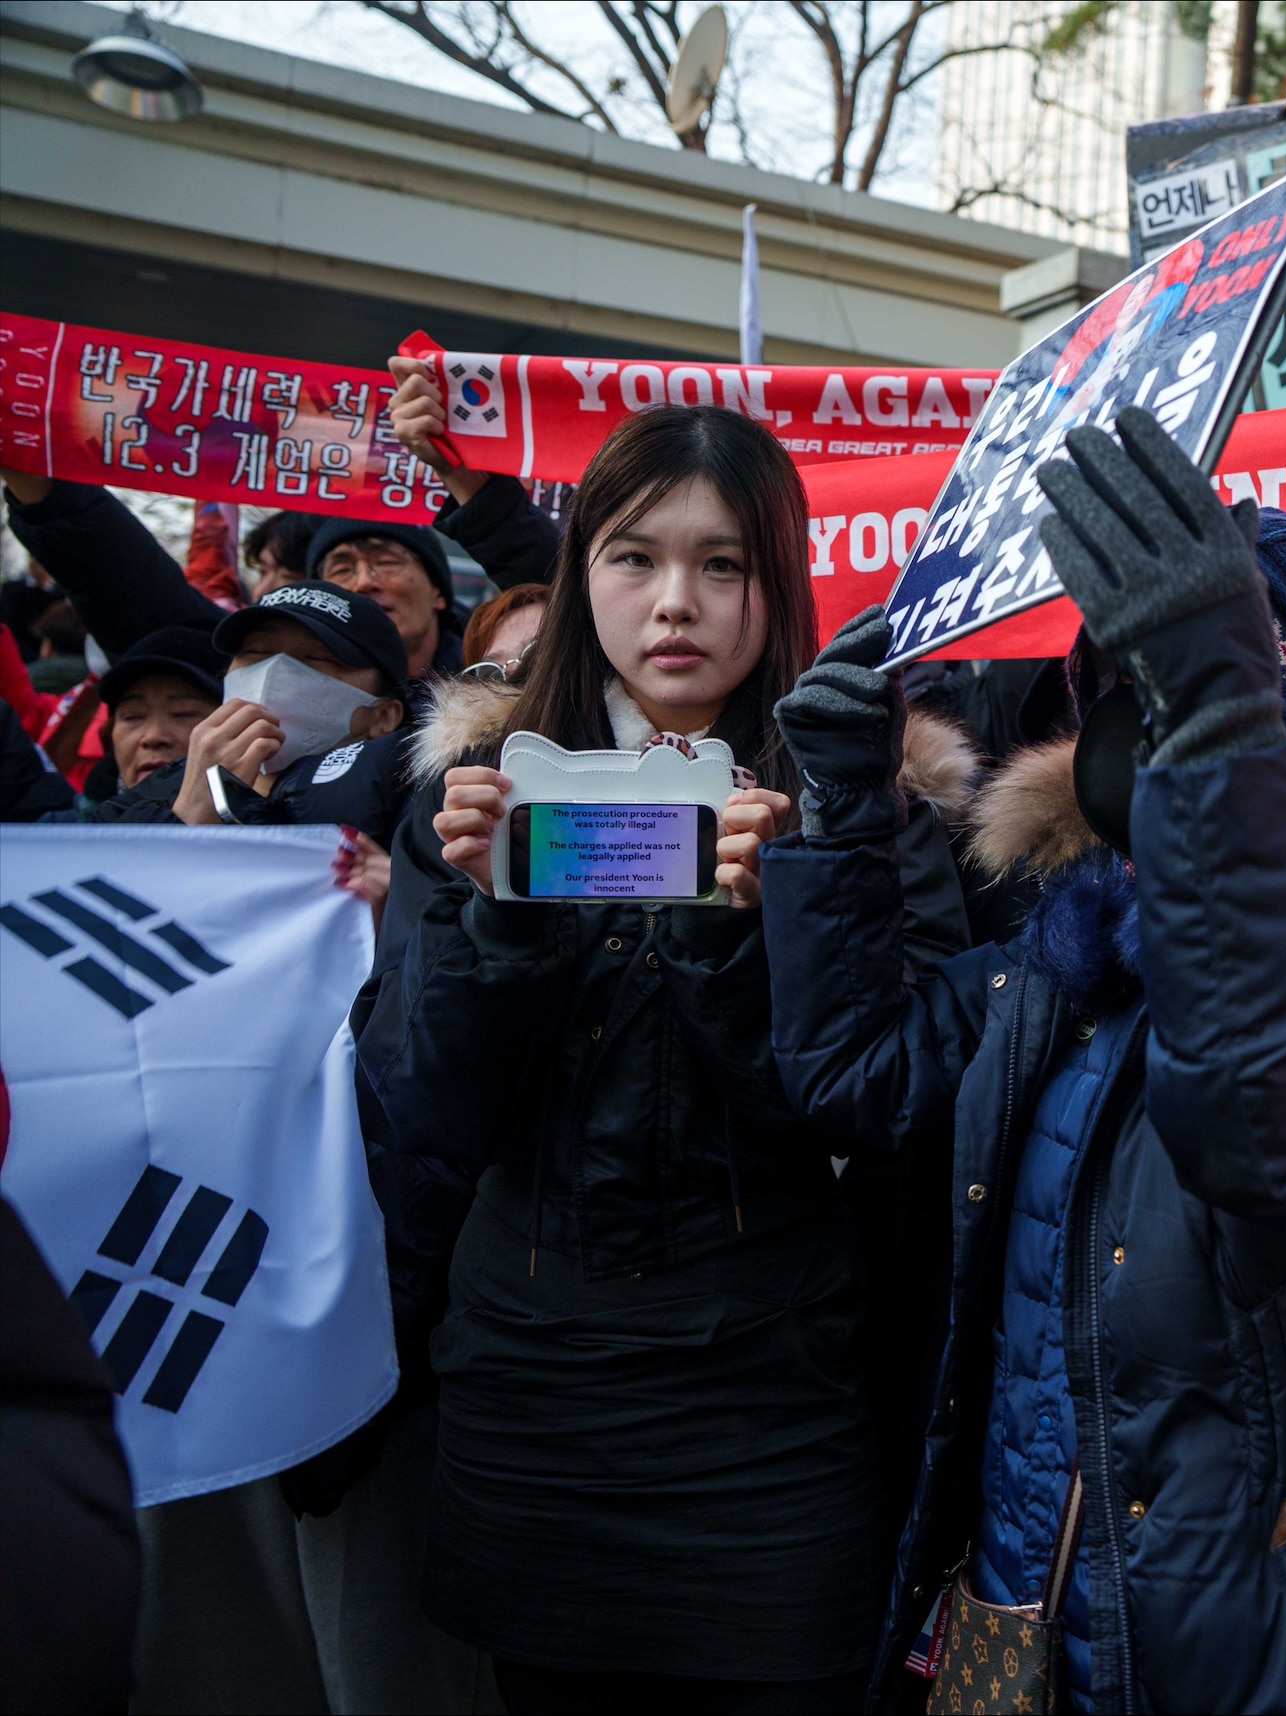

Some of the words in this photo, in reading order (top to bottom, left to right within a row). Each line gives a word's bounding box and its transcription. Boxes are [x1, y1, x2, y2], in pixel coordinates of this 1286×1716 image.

[1178, 253, 1279, 320] YOON
[10, 346, 49, 448] YOON
[79, 342, 303, 430] 반국가세력
[561, 360, 792, 429] YOON,
[813, 373, 1000, 429] AGAI
[969, 362, 1070, 472] 우리
[102, 412, 201, 478] 12.3
[827, 440, 907, 457] GREAT
[807, 507, 931, 578] YOO
[552, 809, 570, 818] The
[571, 809, 629, 820] prosecution
[630, 809, 679, 820] procedure
[574, 821, 594, 829] was
[595, 820, 626, 831] totally
[627, 820, 656, 831] illegal
[549, 841, 567, 850] The
[568, 841, 607, 852] charges
[608, 841, 643, 852] applied
[665, 842, 681, 850] not
[578, 852, 616, 862] leagally
[617, 852, 651, 862] applied
[565, 873, 581, 882] Our
[584, 873, 630, 883] president
[632, 873, 655, 882] Yoon
[656, 873, 664, 882] is
[594, 884, 636, 893] innocent
